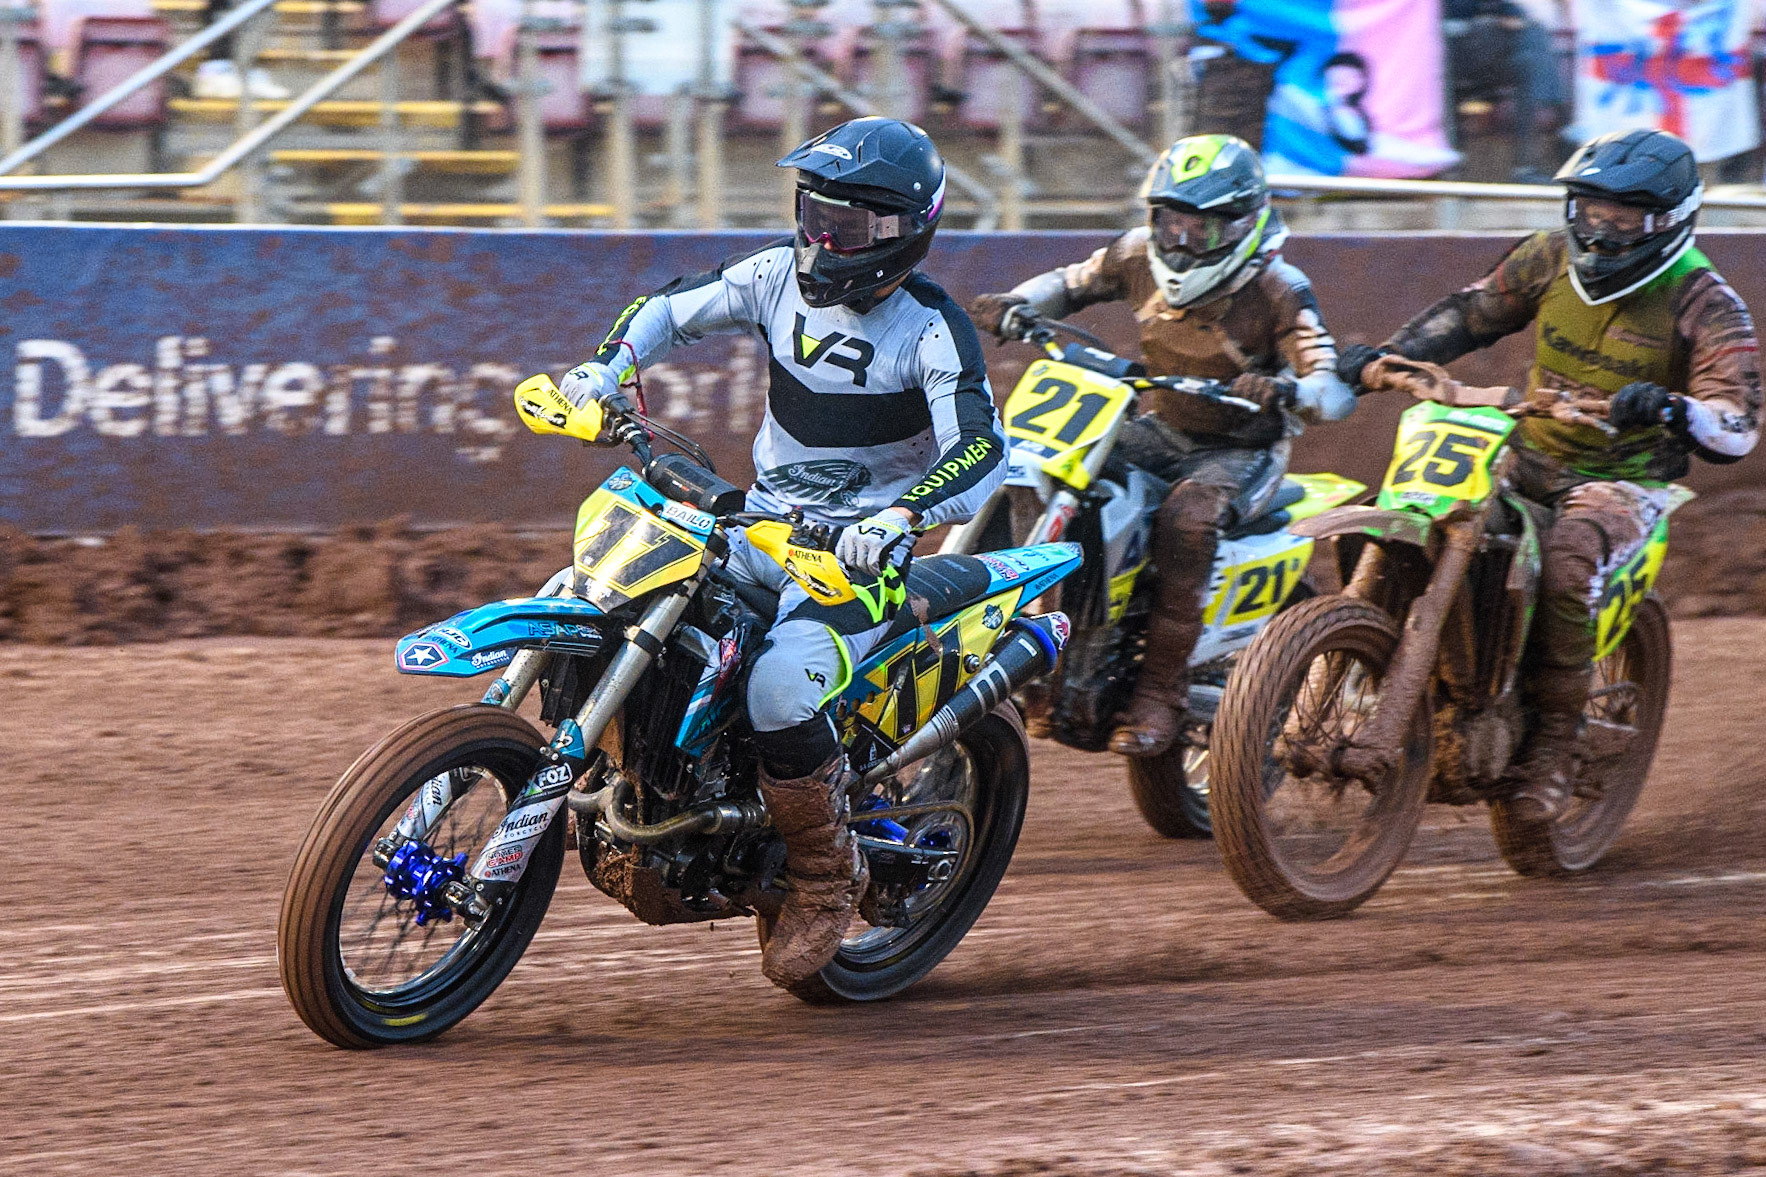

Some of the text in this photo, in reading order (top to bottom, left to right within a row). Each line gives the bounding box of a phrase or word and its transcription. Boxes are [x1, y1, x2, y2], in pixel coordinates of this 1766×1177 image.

[793, 311, 875, 388] VR
[13, 336, 519, 463] Delivering
[1011, 377, 1111, 445] 21
[1392, 431, 1492, 488] 25
[788, 464, 836, 487] Indian
[857, 525, 888, 541] VR
[794, 550, 822, 563] ATHENA
[1233, 559, 1287, 615] 21
[471, 650, 507, 666] Indian
[491, 811, 549, 839] Indian
[492, 864, 521, 877] ATHENA
